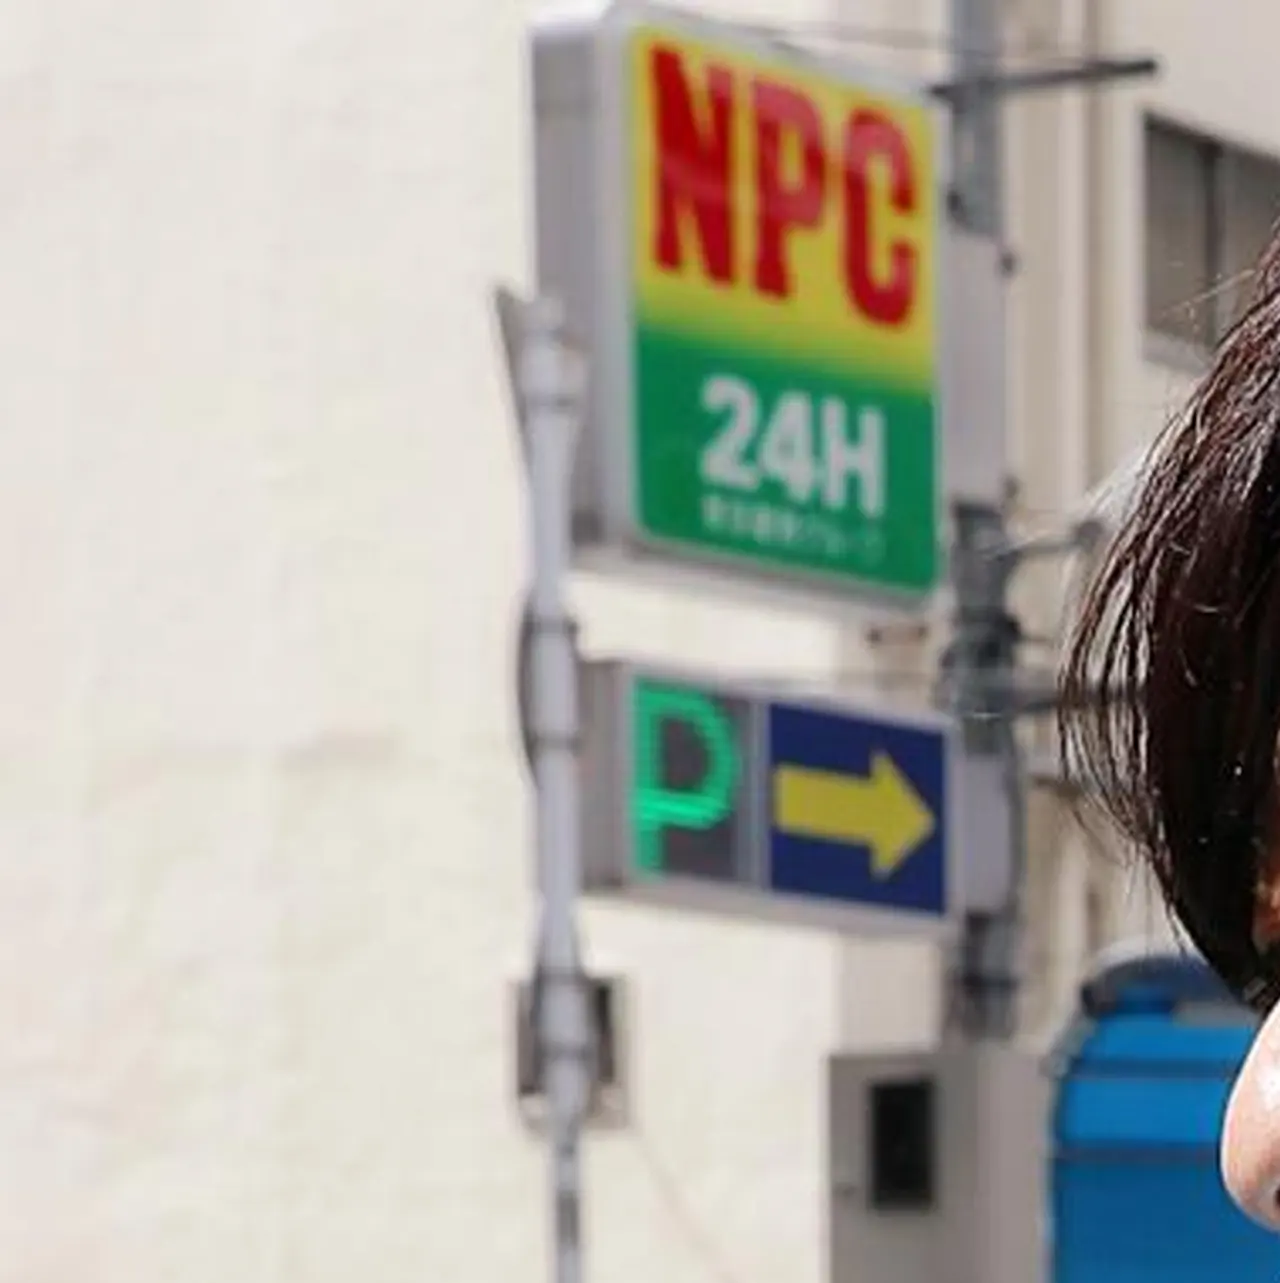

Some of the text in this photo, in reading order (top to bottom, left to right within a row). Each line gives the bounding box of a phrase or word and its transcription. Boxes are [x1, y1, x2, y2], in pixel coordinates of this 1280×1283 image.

[651, 43, 916, 328] NPC
[702, 375, 886, 516] 24H
[635, 681, 738, 874] P
